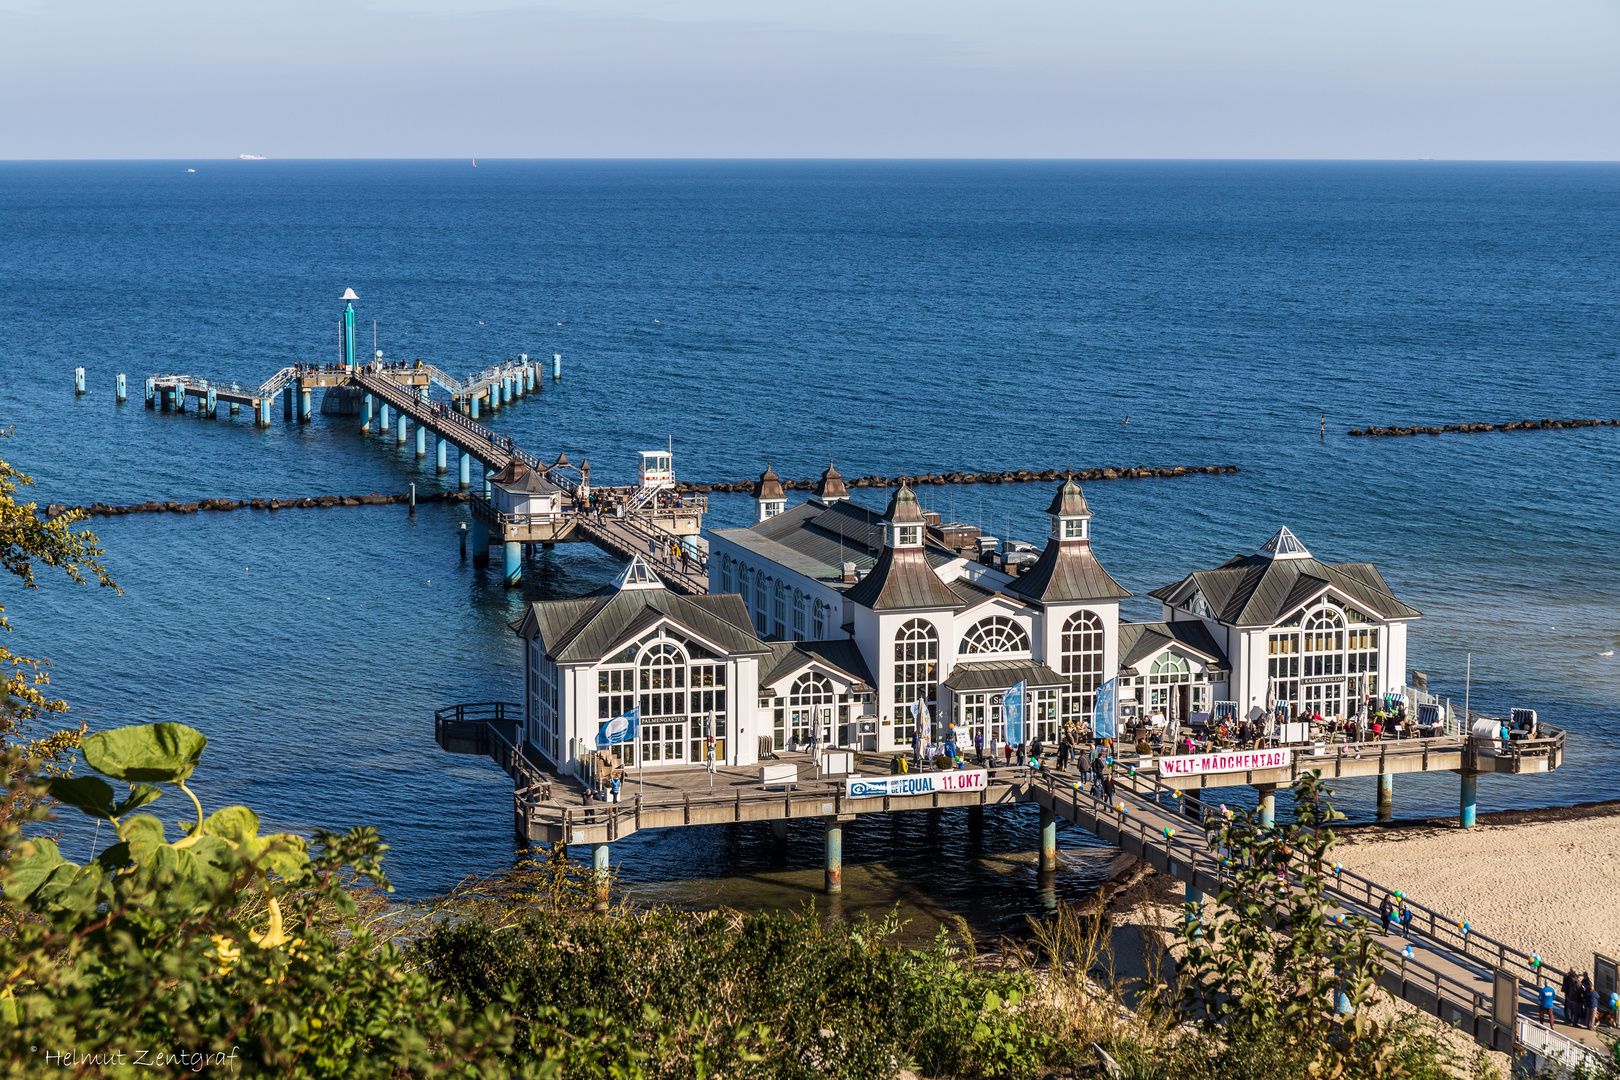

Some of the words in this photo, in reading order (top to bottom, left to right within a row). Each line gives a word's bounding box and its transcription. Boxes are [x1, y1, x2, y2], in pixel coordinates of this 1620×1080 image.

[641, 716, 686, 724] PALMENGARTEN
[1164, 752, 1286, 773] WELT-MÄDCHENTAG!
[903, 777, 935, 795] EQUAL
[942, 775, 957, 790] 11.
[958, 774, 983, 789] OKT.
